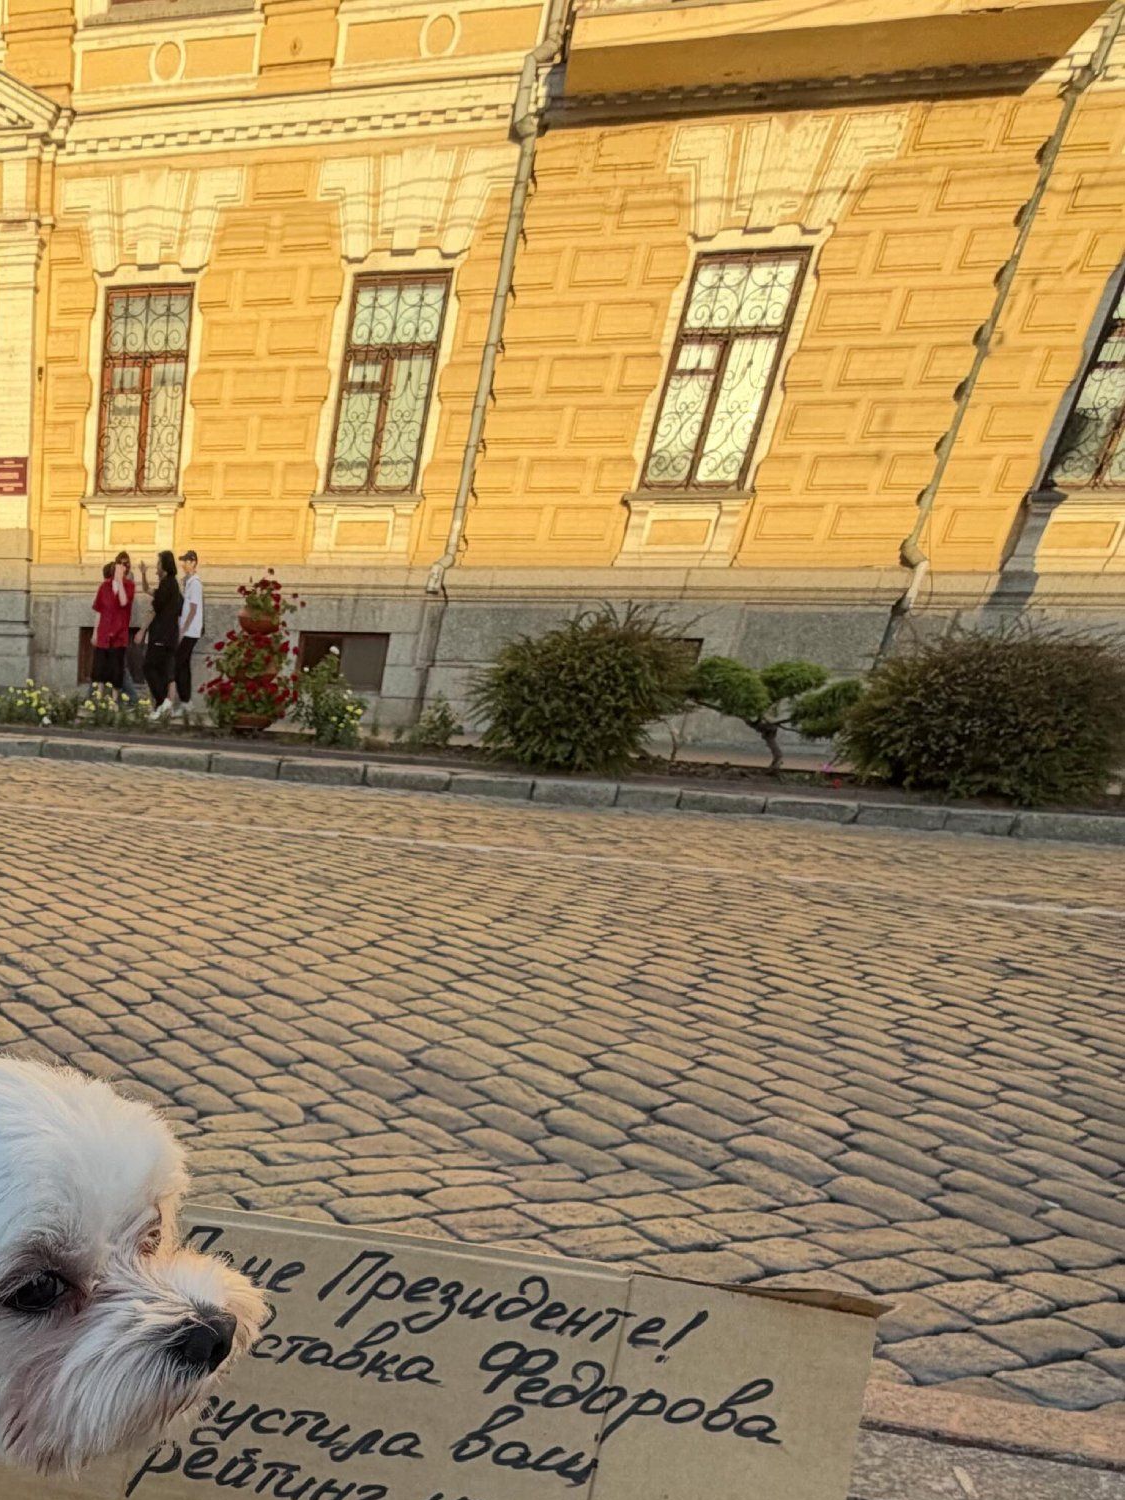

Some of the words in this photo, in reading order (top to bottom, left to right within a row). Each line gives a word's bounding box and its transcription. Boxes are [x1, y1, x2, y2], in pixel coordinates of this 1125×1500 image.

[181, 1225, 305, 1293] Пне
[317, 1250, 708, 1364] Президенте!
[249, 1301, 444, 1388] ставка
[478, 1340, 781, 1445] Федорова
